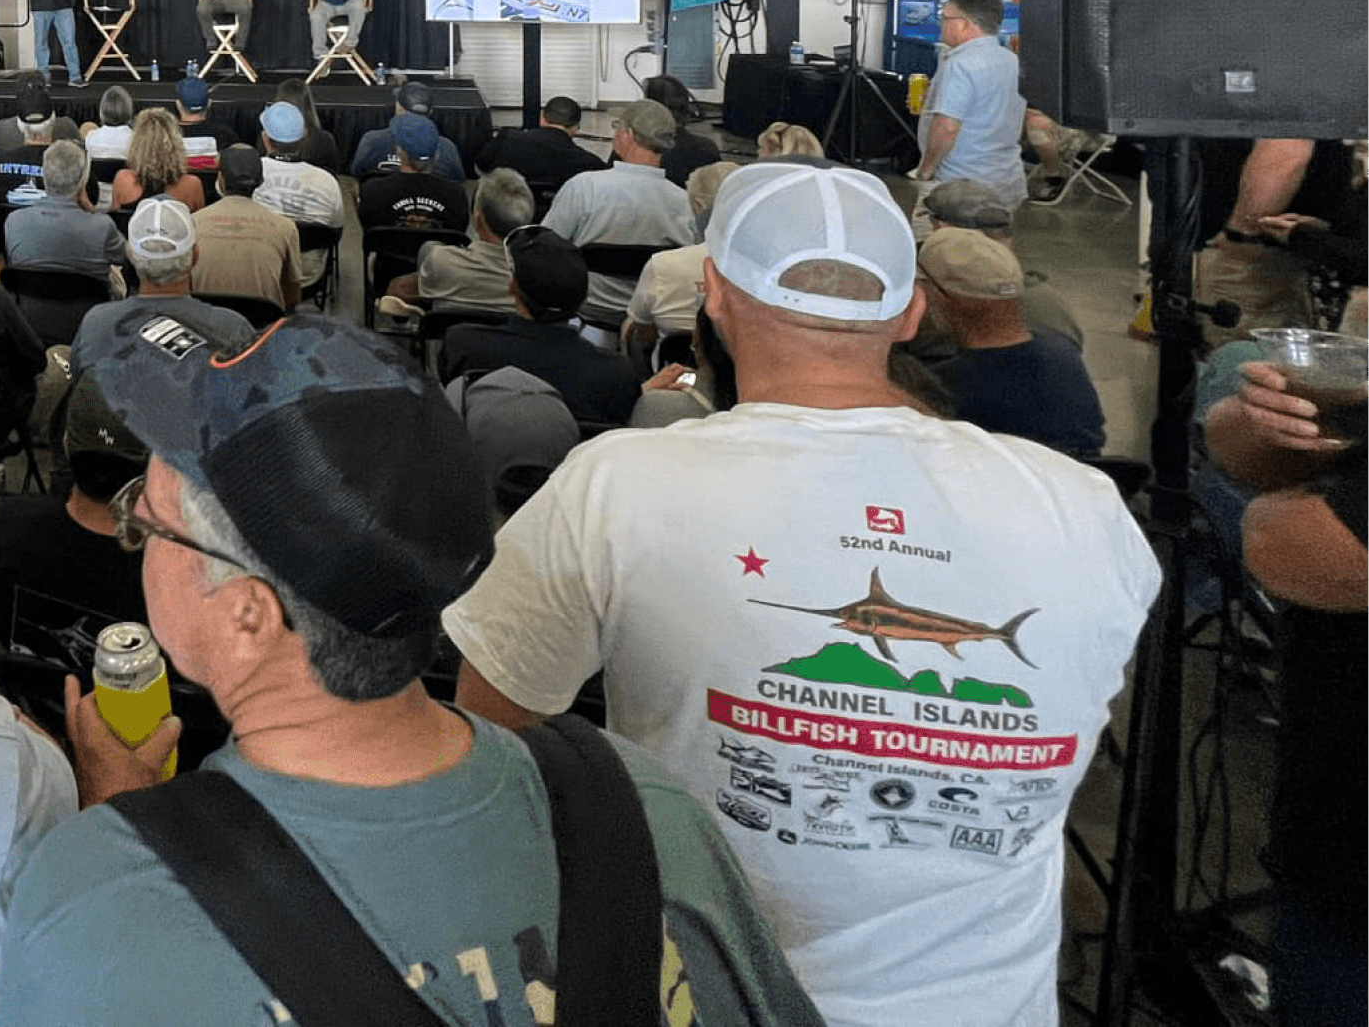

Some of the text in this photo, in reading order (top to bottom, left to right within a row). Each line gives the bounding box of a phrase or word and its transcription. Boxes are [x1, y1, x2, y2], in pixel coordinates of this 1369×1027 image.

[839, 535, 951, 563] 52nd Annual
[757, 679, 1039, 733] CHANNEL ISLANDS
[731, 704, 1066, 765] BILLFISH TOURNAMENT
[812, 754, 884, 773] Channel
[928, 800, 980, 816] COSTA
[956, 829, 997, 849] AAA
